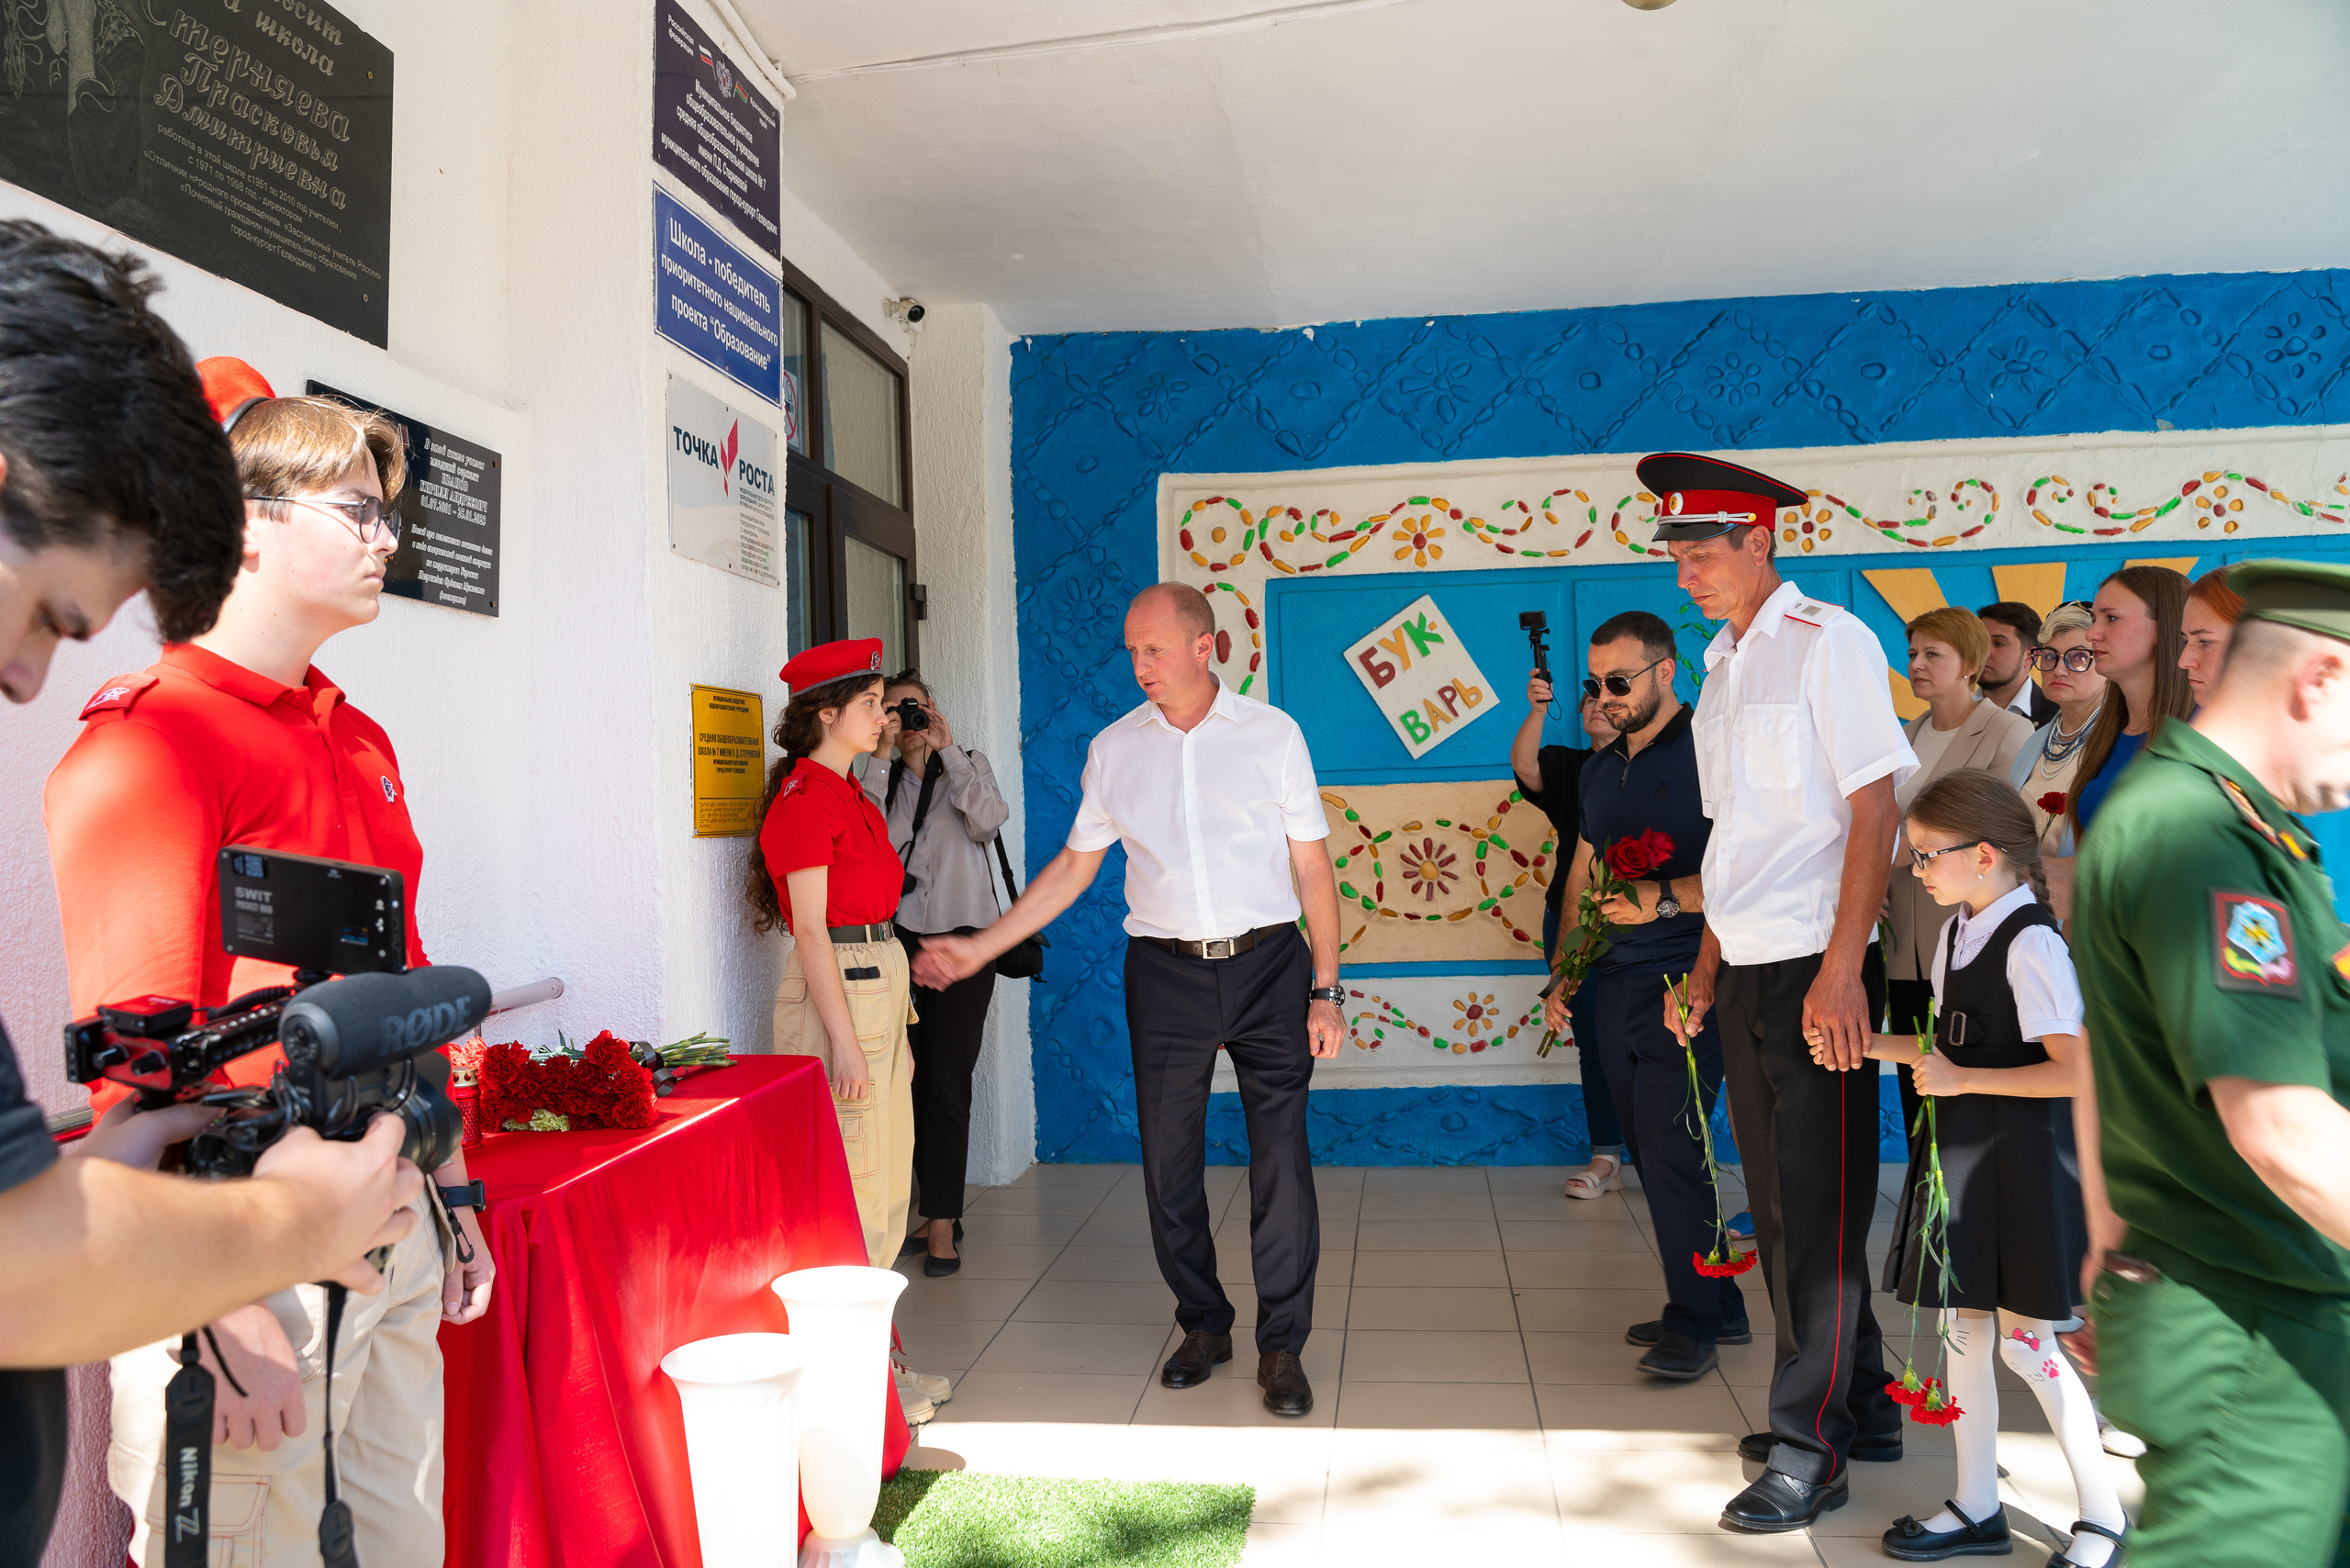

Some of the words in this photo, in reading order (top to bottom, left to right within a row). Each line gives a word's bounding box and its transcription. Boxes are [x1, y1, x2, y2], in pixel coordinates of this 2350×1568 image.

[255, 10, 334, 76] школа
[153, 73, 347, 210] Дмитриевна
[180, 52, 338, 172] Прасковья
[157, 124, 196, 151] работала
[197, 146, 203, 155] в
[204, 150, 221, 165] этой
[222, 160, 246, 179] школе
[279, 190, 296, 207] 2010
[296, 201, 308, 215] год
[188, 156, 194, 164] с
[196, 158, 213, 175] 1971
[215, 170, 225, 181] по
[245, 186, 258, 201] год
[262, 196, 303, 224] директором
[661, 131, 701, 174] муниципального
[700, 164, 730, 197] образования
[189, 173, 229, 200] народного
[331, 248, 357, 267] учитель
[224, 206, 263, 232] гражданин
[263, 226, 318, 260] муниципального
[669, 217, 707, 266] Школа
[714, 257, 771, 314] победитель
[661, 252, 722, 308] приоритетного
[723, 297, 778, 347] национального
[671, 294, 709, 332] проекта
[423, 437, 431, 450] В
[673, 425, 720, 470] ТОЧКА
[441, 472, 469, 493] ИВАНОВ
[739, 458, 776, 497] РОСТА
[1398, 677, 1483, 745] ВАРЬ
[234, 885, 274, 903] SWIT
[178, 1446, 199, 1509] Nikon
[174, 1506, 200, 1544] Z
